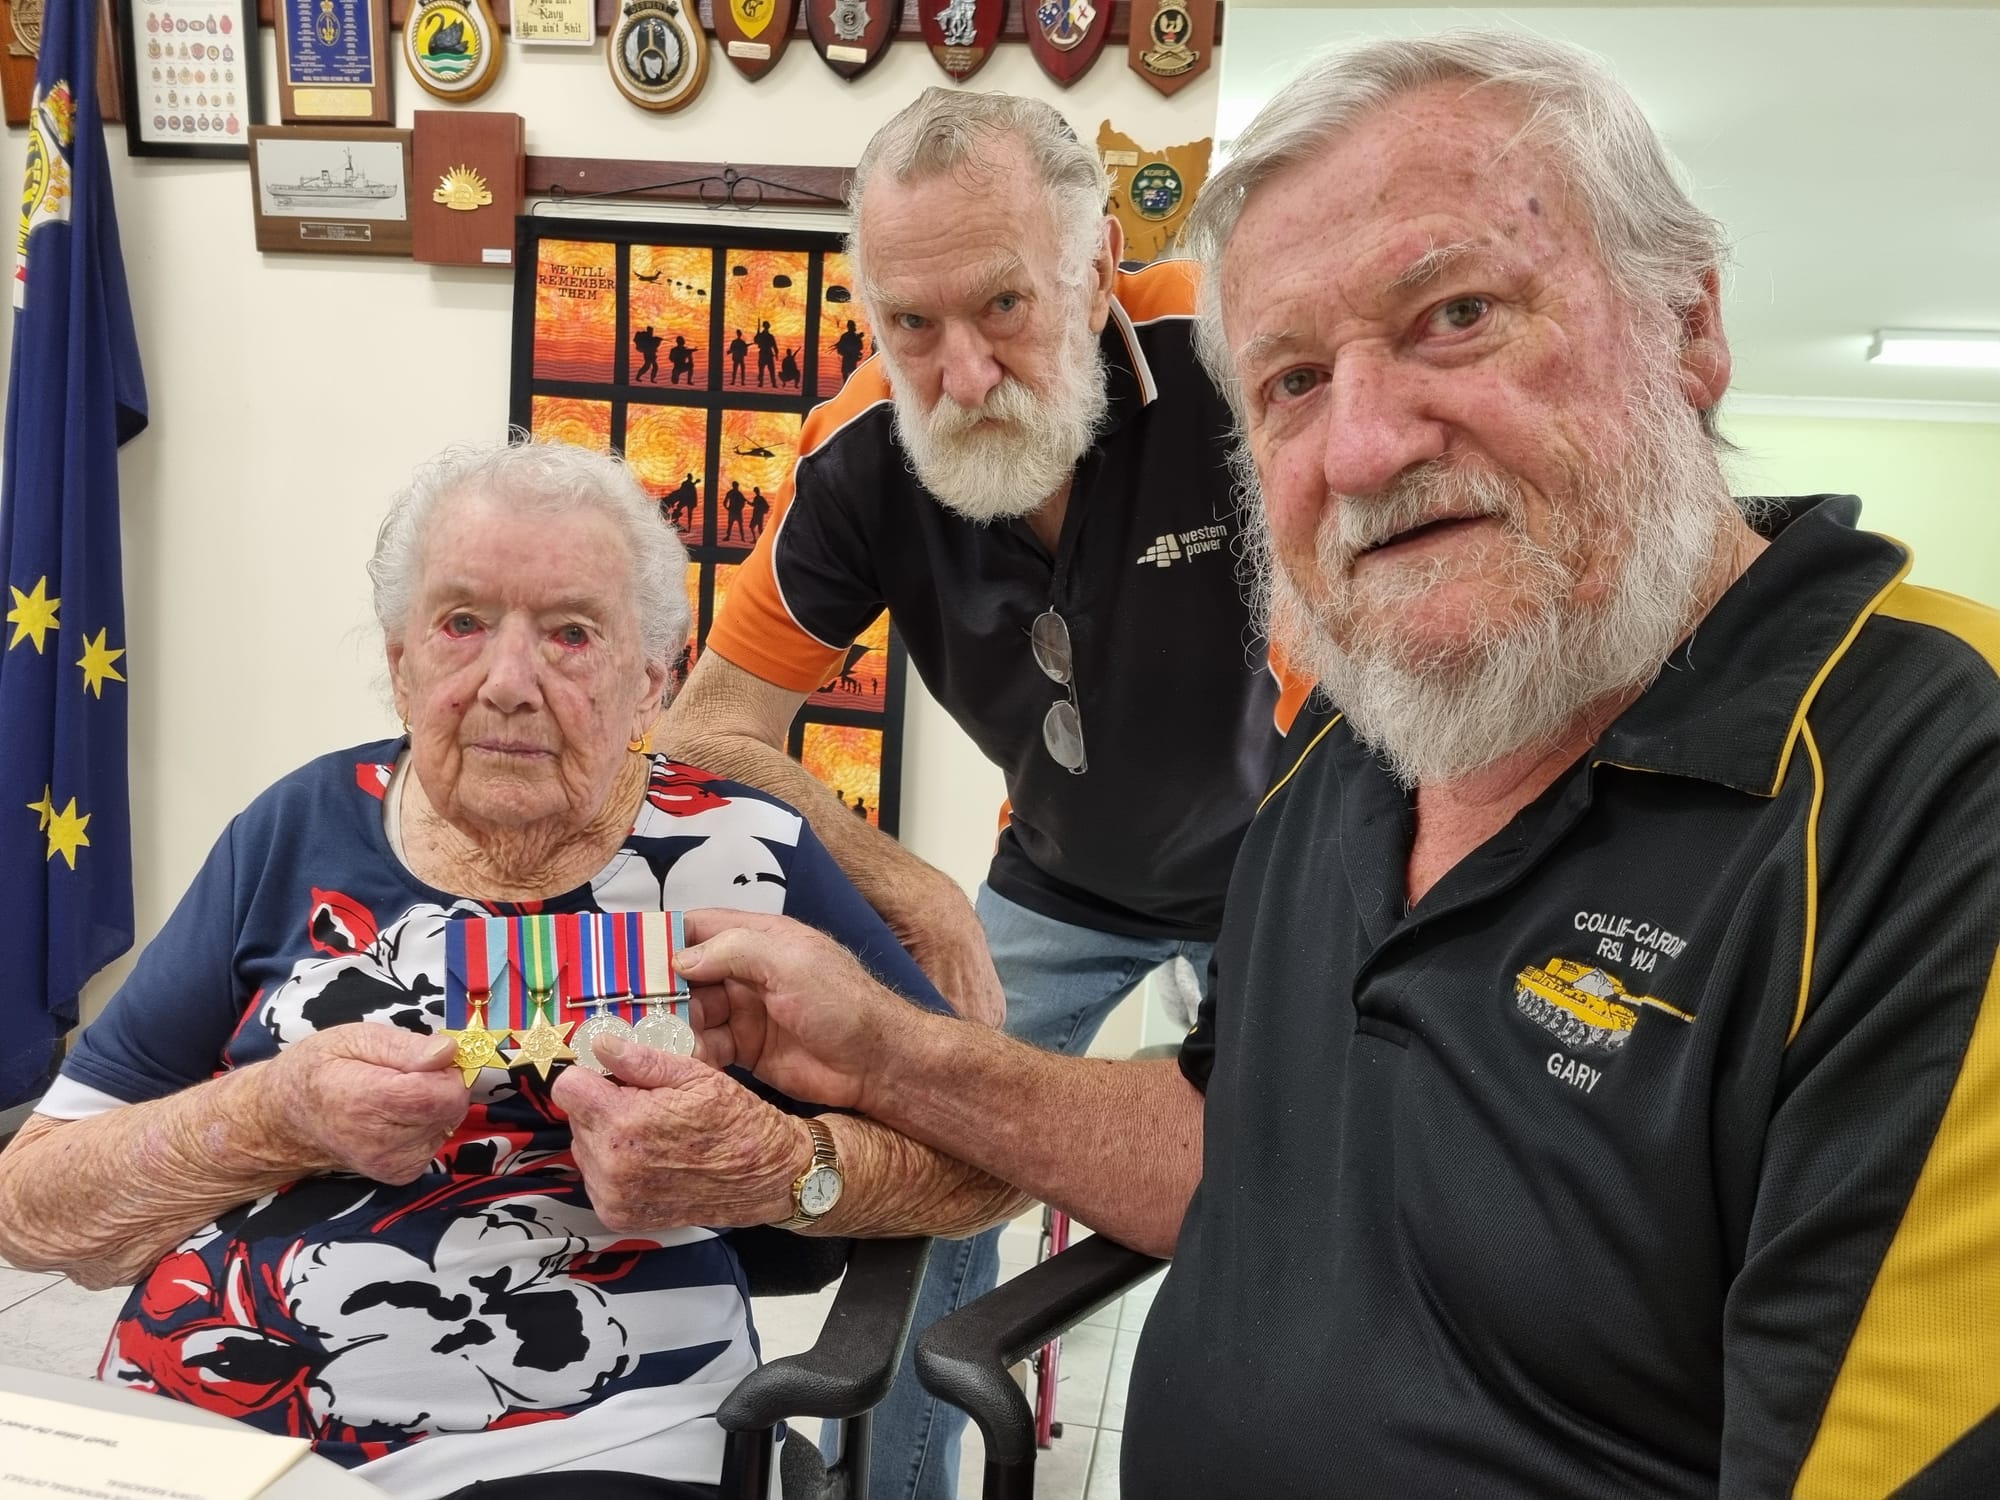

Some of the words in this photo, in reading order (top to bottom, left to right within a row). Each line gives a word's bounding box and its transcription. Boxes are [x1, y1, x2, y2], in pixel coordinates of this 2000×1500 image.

[539, 8, 563, 22] Navy
[564, 23, 582, 34] Shit
[551, 264, 568, 275] WE
[572, 266, 605, 277] WILL
[538, 275, 614, 289] REMEMBER
[559, 288, 597, 300] THEM
[1178, 524, 1228, 545] western
[1185, 538, 1221, 564] power
[1596, 937, 1624, 963] RSL
[1629, 947, 1658, 974] WA
[1546, 1052, 1602, 1094] GARY
